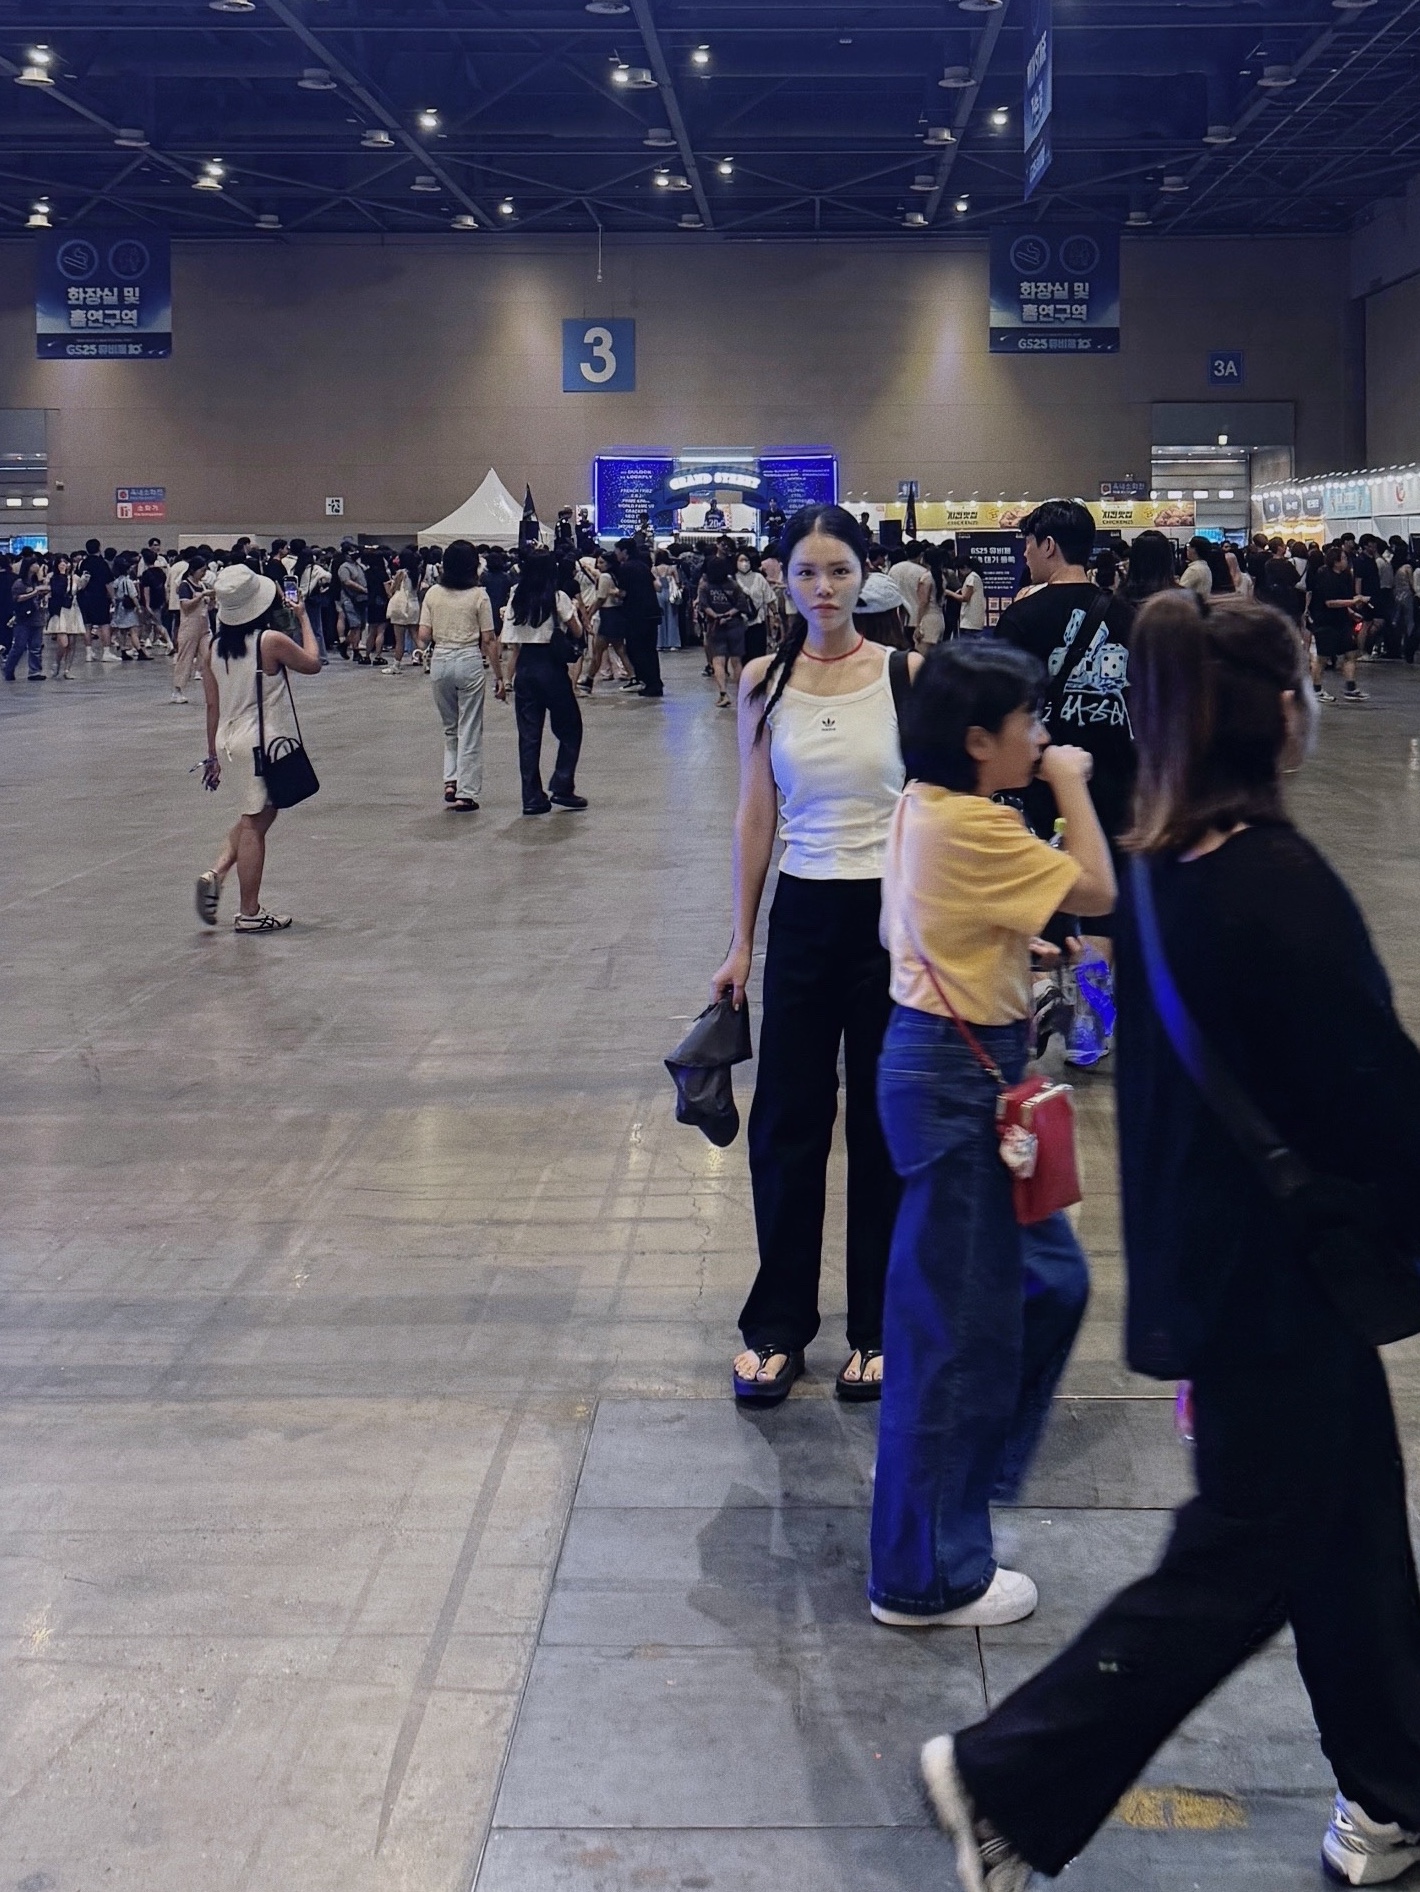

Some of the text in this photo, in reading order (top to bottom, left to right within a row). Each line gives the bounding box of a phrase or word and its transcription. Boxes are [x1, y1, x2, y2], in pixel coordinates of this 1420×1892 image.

[67, 287, 140, 305] 화장실 및
[1020, 281, 1090, 299] 화장실 및
[66, 344, 97, 355] GS25
[1018, 338, 1048, 349] GS25
[580, 327, 617, 383] 3
[1213, 360, 1238, 377] 3A
